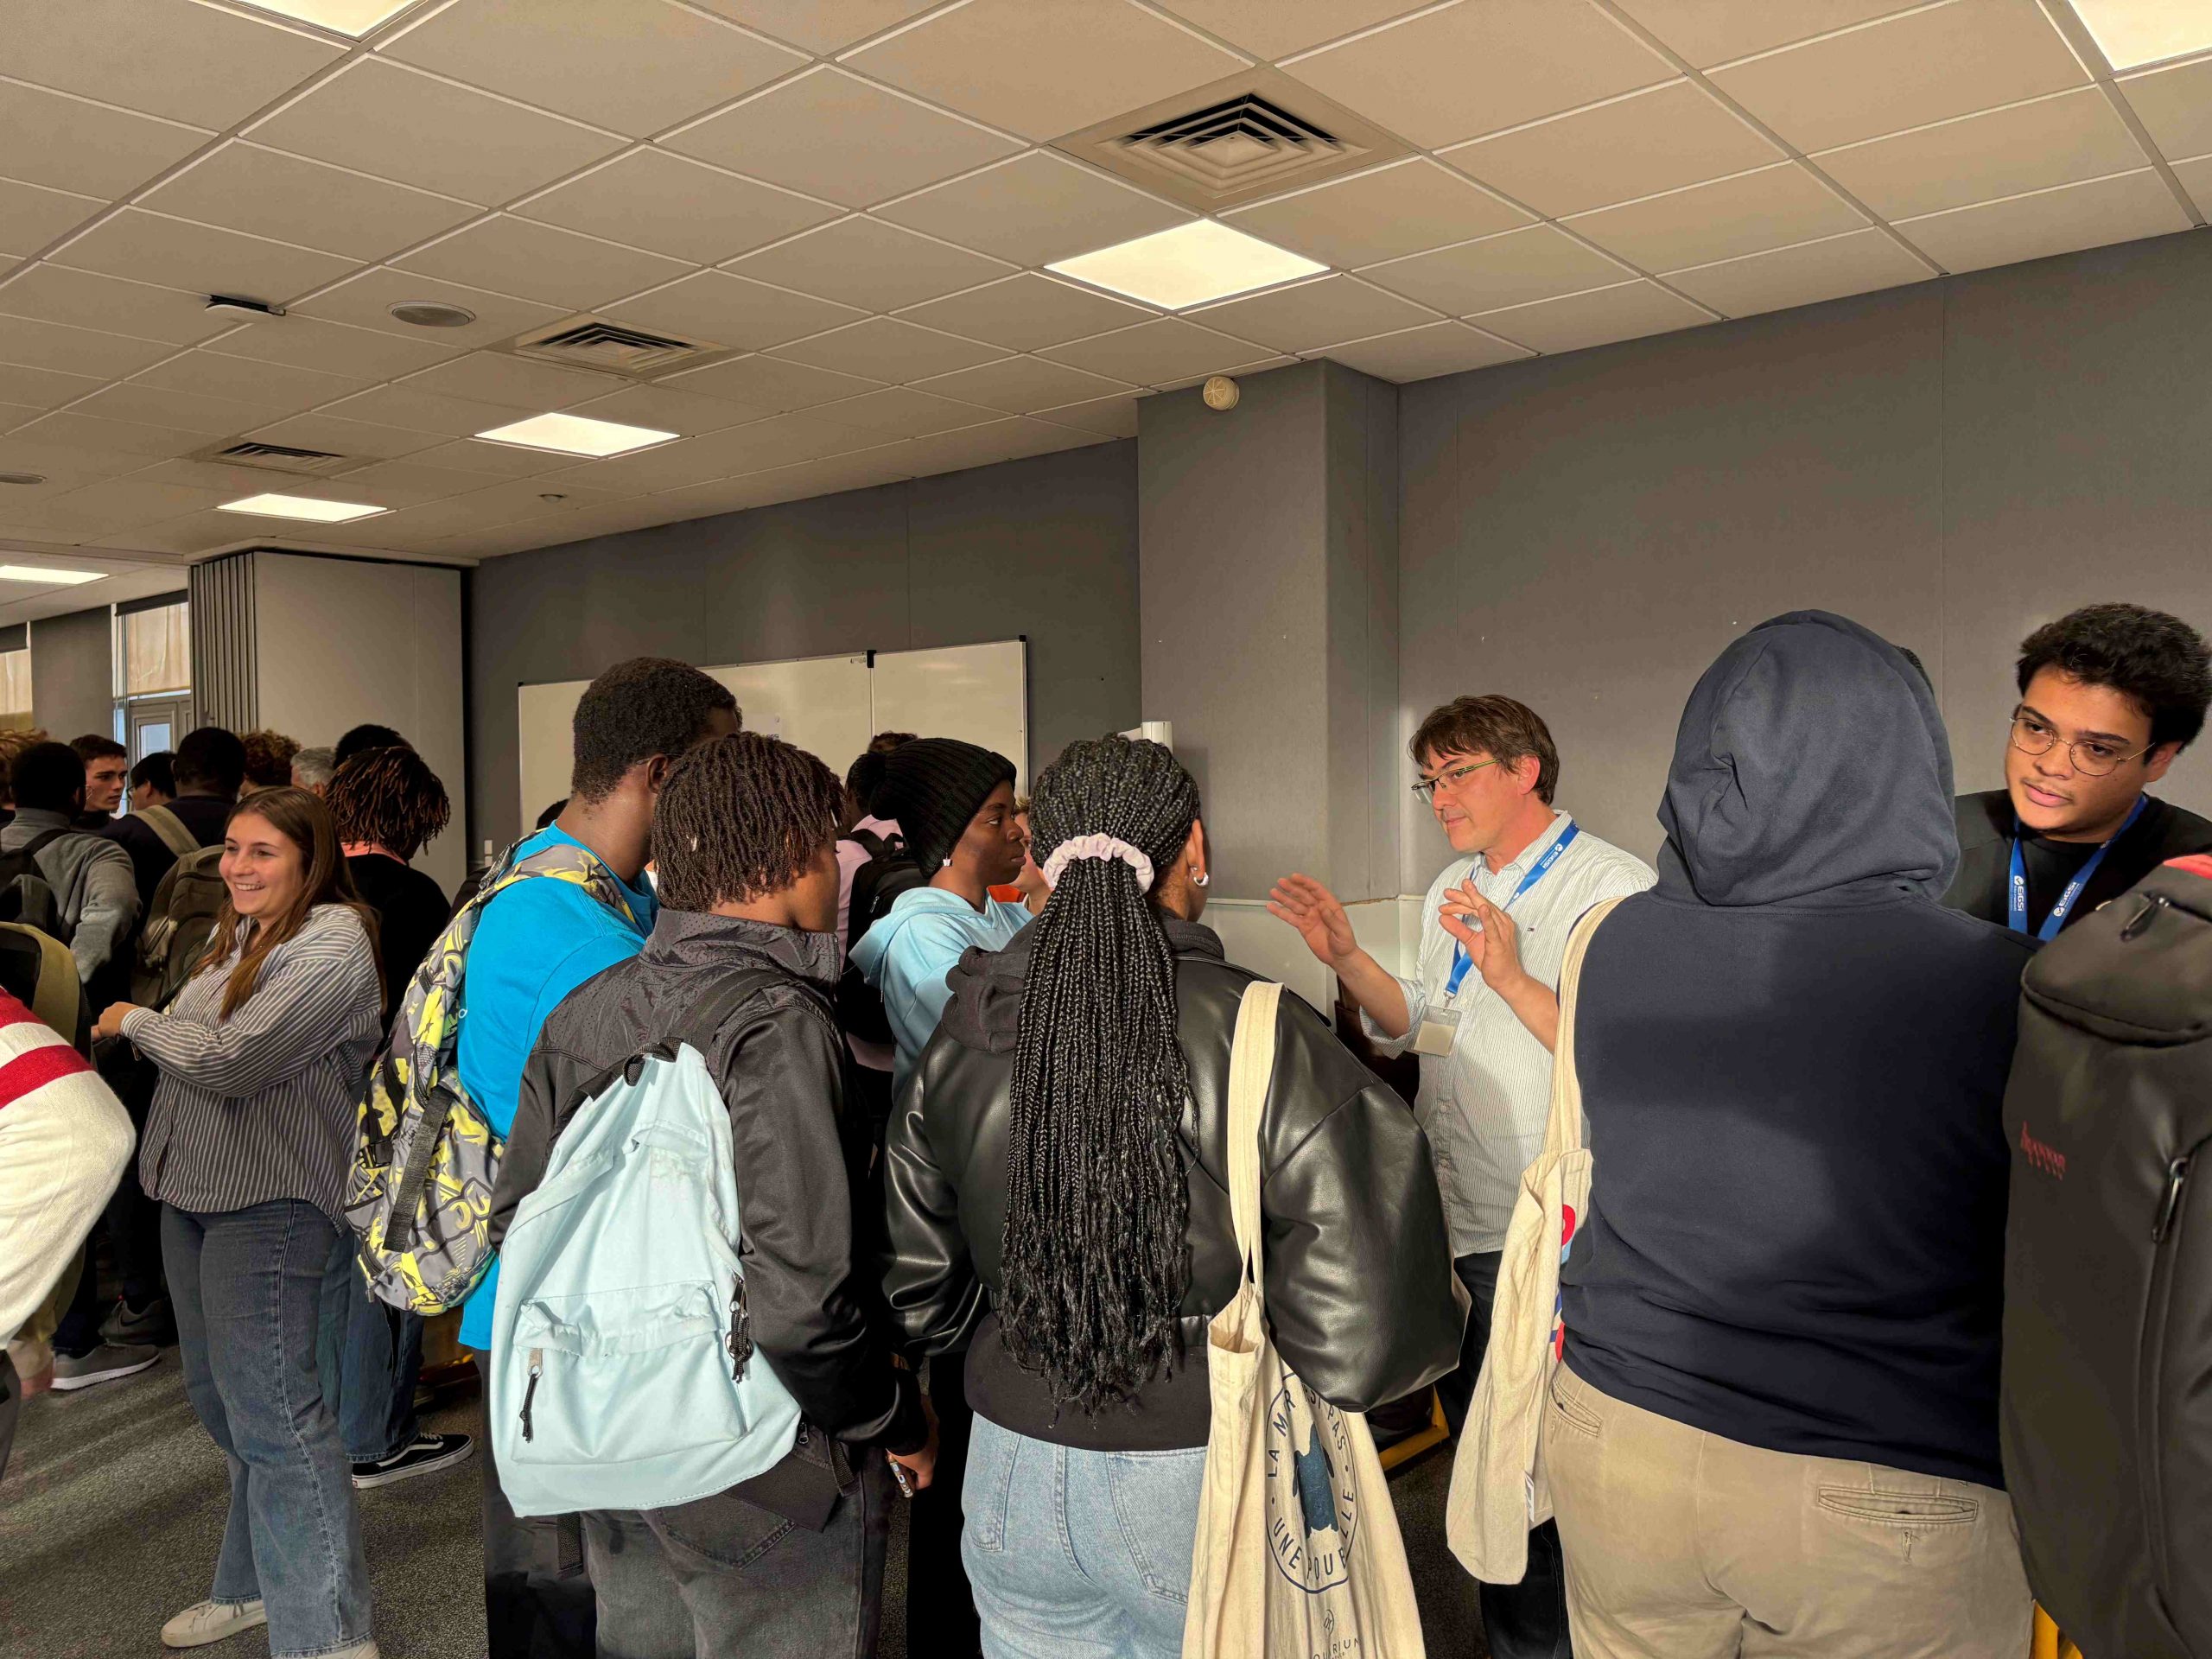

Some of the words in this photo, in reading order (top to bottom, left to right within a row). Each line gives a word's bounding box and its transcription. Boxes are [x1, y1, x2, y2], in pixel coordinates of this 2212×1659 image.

[2058, 881, 2077, 907] EIGSI
[1272, 1389, 1296, 1437] MR
[1327, 1404, 1346, 1450] PAS
[1268, 1449, 1281, 1478] LA
[1273, 1516, 1302, 1570] UNE
